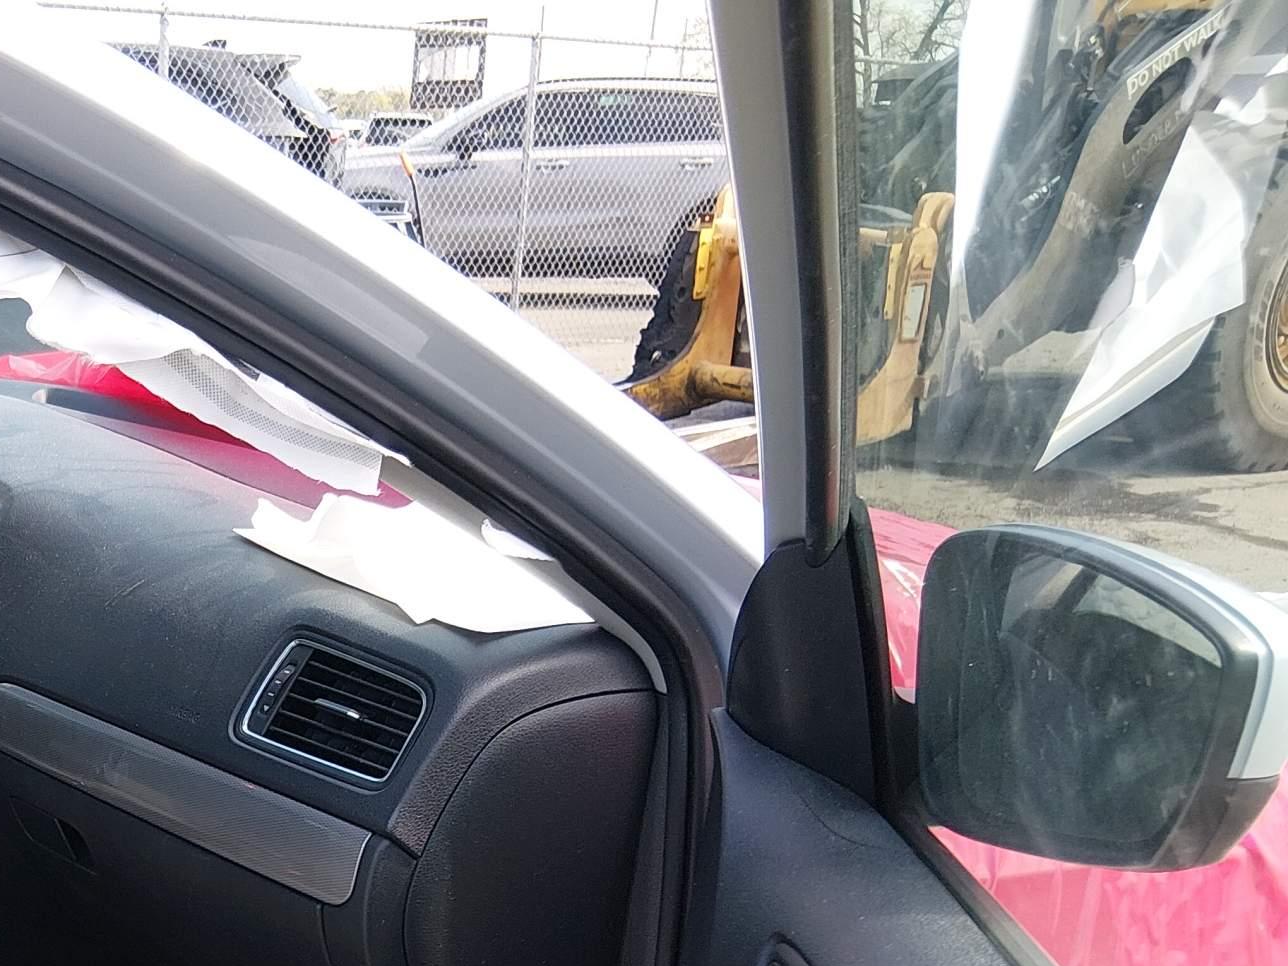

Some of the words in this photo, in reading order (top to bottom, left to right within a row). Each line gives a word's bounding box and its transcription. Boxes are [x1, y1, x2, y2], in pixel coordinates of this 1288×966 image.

[1129, 72, 1149, 95] DO
[1152, 45, 1181, 76] NOT
[1183, 14, 1224, 52] WALK
